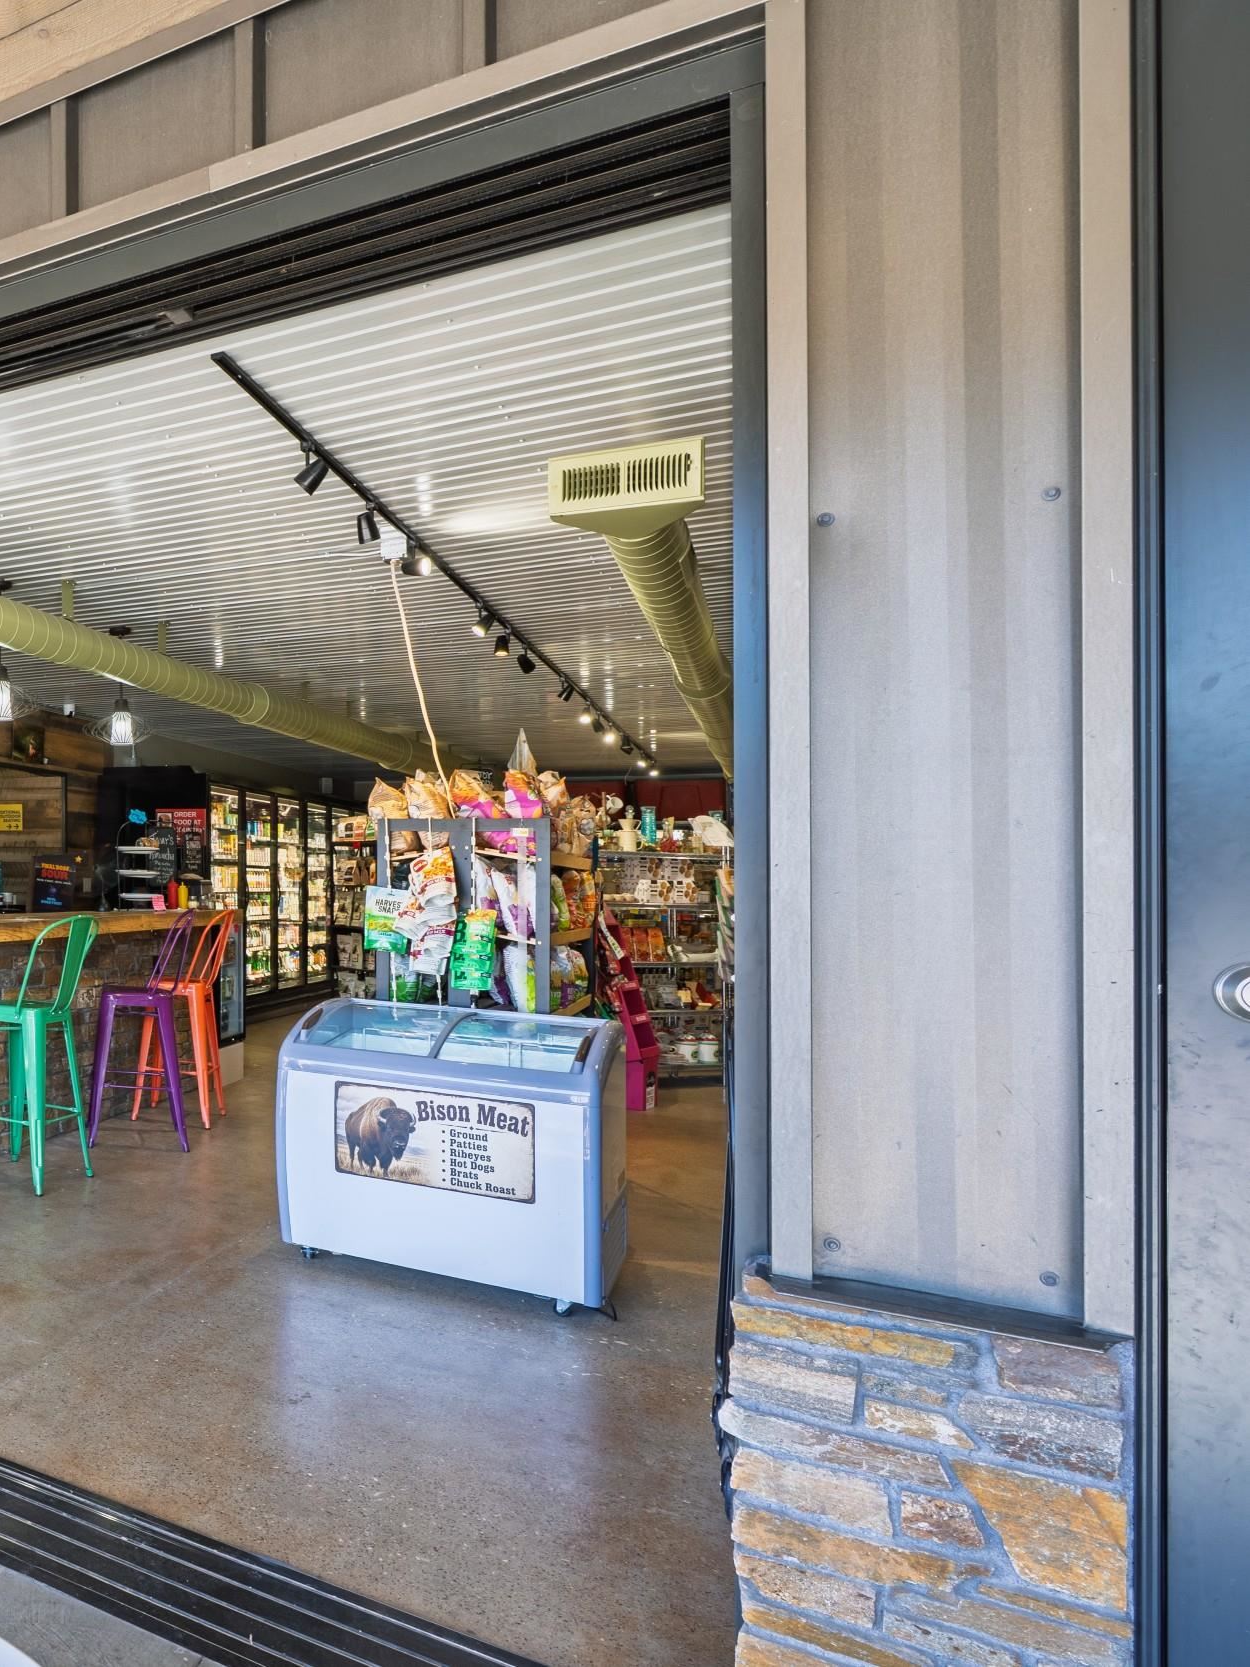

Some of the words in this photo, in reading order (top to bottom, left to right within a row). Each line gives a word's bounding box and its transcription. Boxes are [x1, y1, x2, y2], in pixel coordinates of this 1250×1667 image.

[375, 899, 402, 908] HARVES
[415, 1100, 471, 1122] Bison
[477, 1103, 530, 1137] Meat
[449, 1129, 488, 1142] Ground
[449, 1139, 488, 1152] Patties
[449, 1148, 492, 1163] Ribeyes
[449, 1159, 468, 1169] Hot
[470, 1161, 495, 1173] Dogs
[450, 1168, 479, 1180] Brats
[450, 1178, 483, 1190] Chuck
[485, 1183, 517, 1196] Roast
